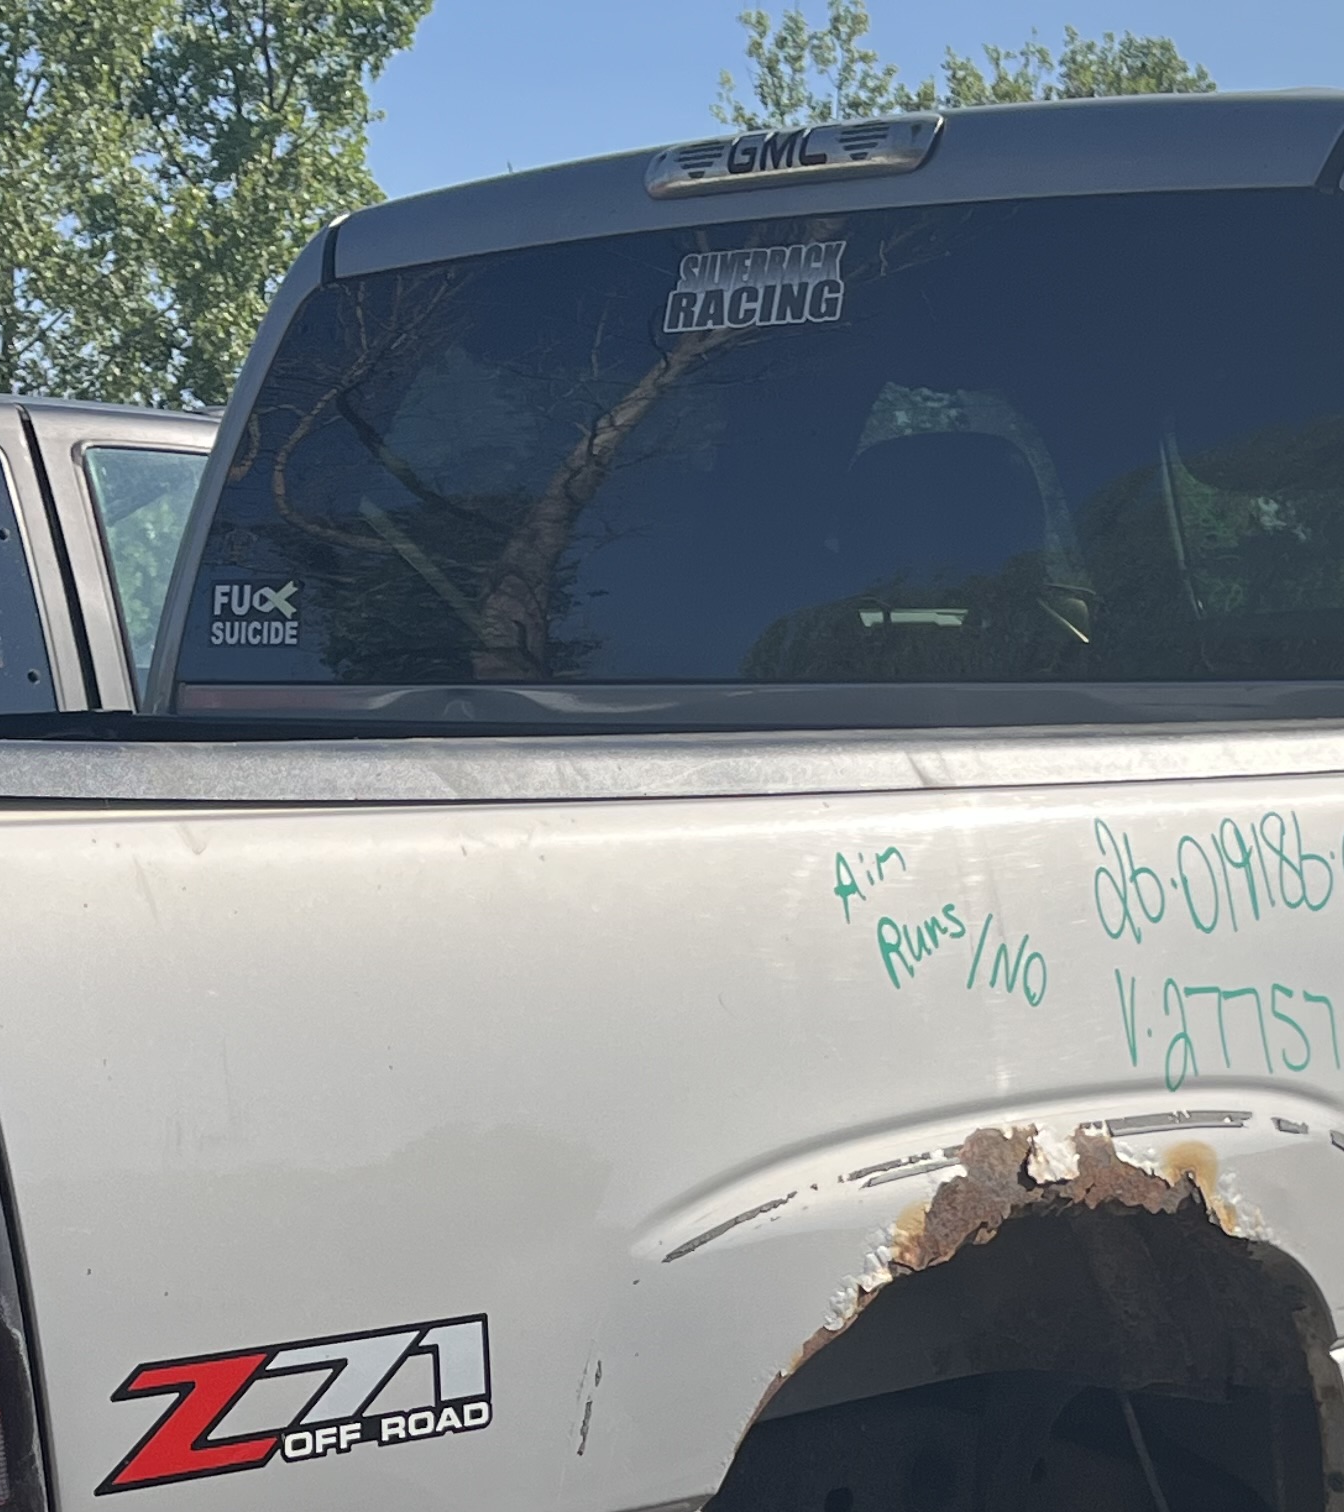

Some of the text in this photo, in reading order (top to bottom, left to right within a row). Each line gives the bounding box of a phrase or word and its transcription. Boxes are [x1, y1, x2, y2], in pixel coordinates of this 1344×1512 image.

[727, 128, 828, 175] GMC
[678, 241, 846, 292] SILVERBACK
[664, 279, 844, 333] RACING
[211, 621, 298, 645] SUICIDE
[94, 1313, 489, 1496] Z71
[282, 1400, 491, 1461] OFF ROAD
